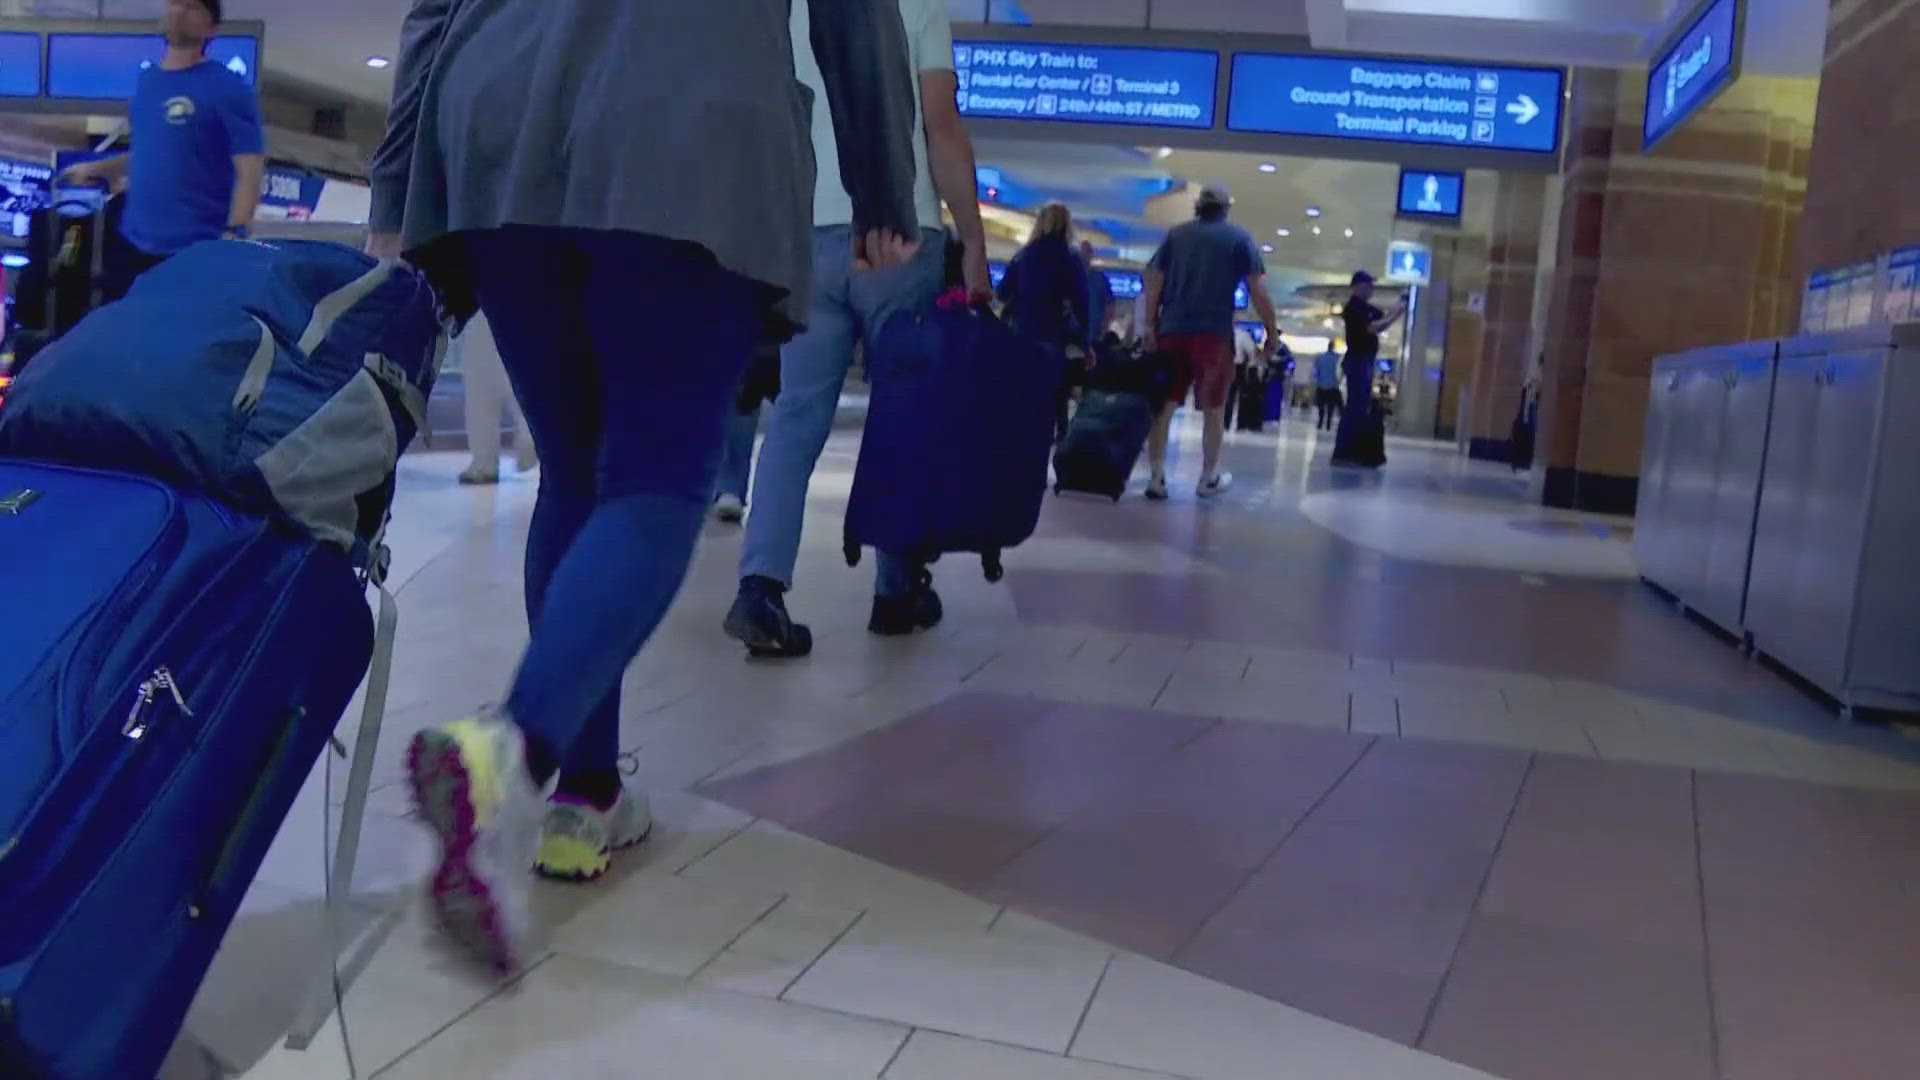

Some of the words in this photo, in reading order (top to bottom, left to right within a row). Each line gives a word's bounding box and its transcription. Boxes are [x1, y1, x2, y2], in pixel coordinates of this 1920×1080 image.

[973, 49, 1007, 66] PHX
[1008, 50, 1038, 69] Sky
[1039, 52, 1075, 68] Train
[1077, 53, 1098, 69] to:
[971, 72, 1013, 87] Rental
[1013, 73, 1037, 88] Car
[1037, 75, 1081, 91] Center
[1115, 78, 1168, 95] Terminal
[1351, 67, 1423, 90] Baggage
[1424, 72, 1471, 91] Claim
[968, 94, 1027, 114] Economy
[1290, 86, 1350, 106] Ground
[1352, 90, 1469, 114] Transportation
[1335, 112, 1404, 133] Terminal
[1405, 117, 1468, 141] Parking
